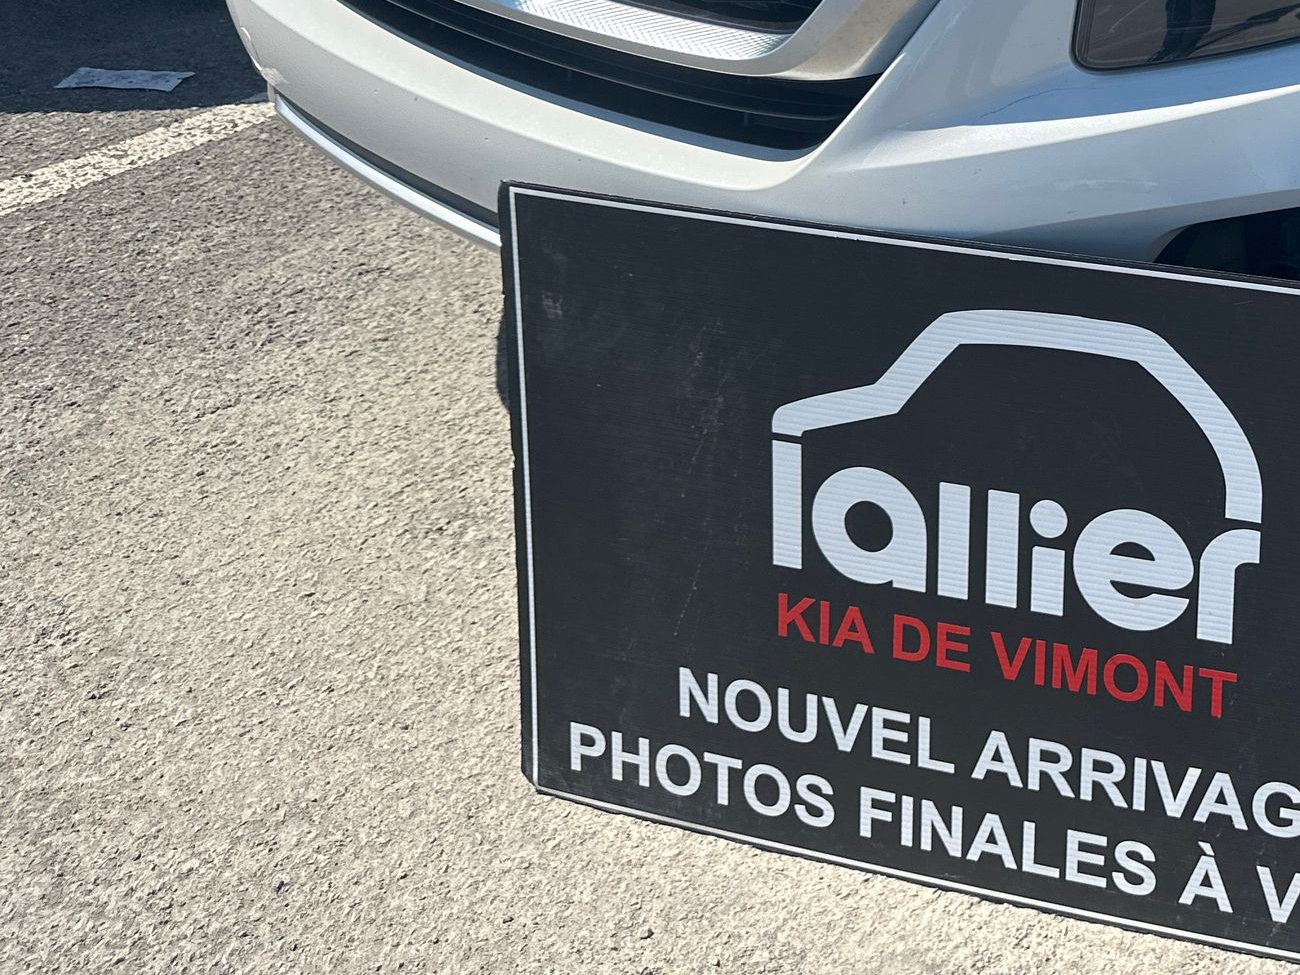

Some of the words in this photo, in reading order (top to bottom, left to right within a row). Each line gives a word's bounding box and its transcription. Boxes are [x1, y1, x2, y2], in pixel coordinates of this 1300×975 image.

[777, 592, 874, 654] KIA
[892, 614, 971, 673] DE
[991, 631, 1239, 719] VIMONT
[678, 666, 955, 774] NOUVEL
[569, 721, 835, 827] PHOTOS
[859, 785, 1158, 898] FINALES
[1180, 841, 1232, 914] À
